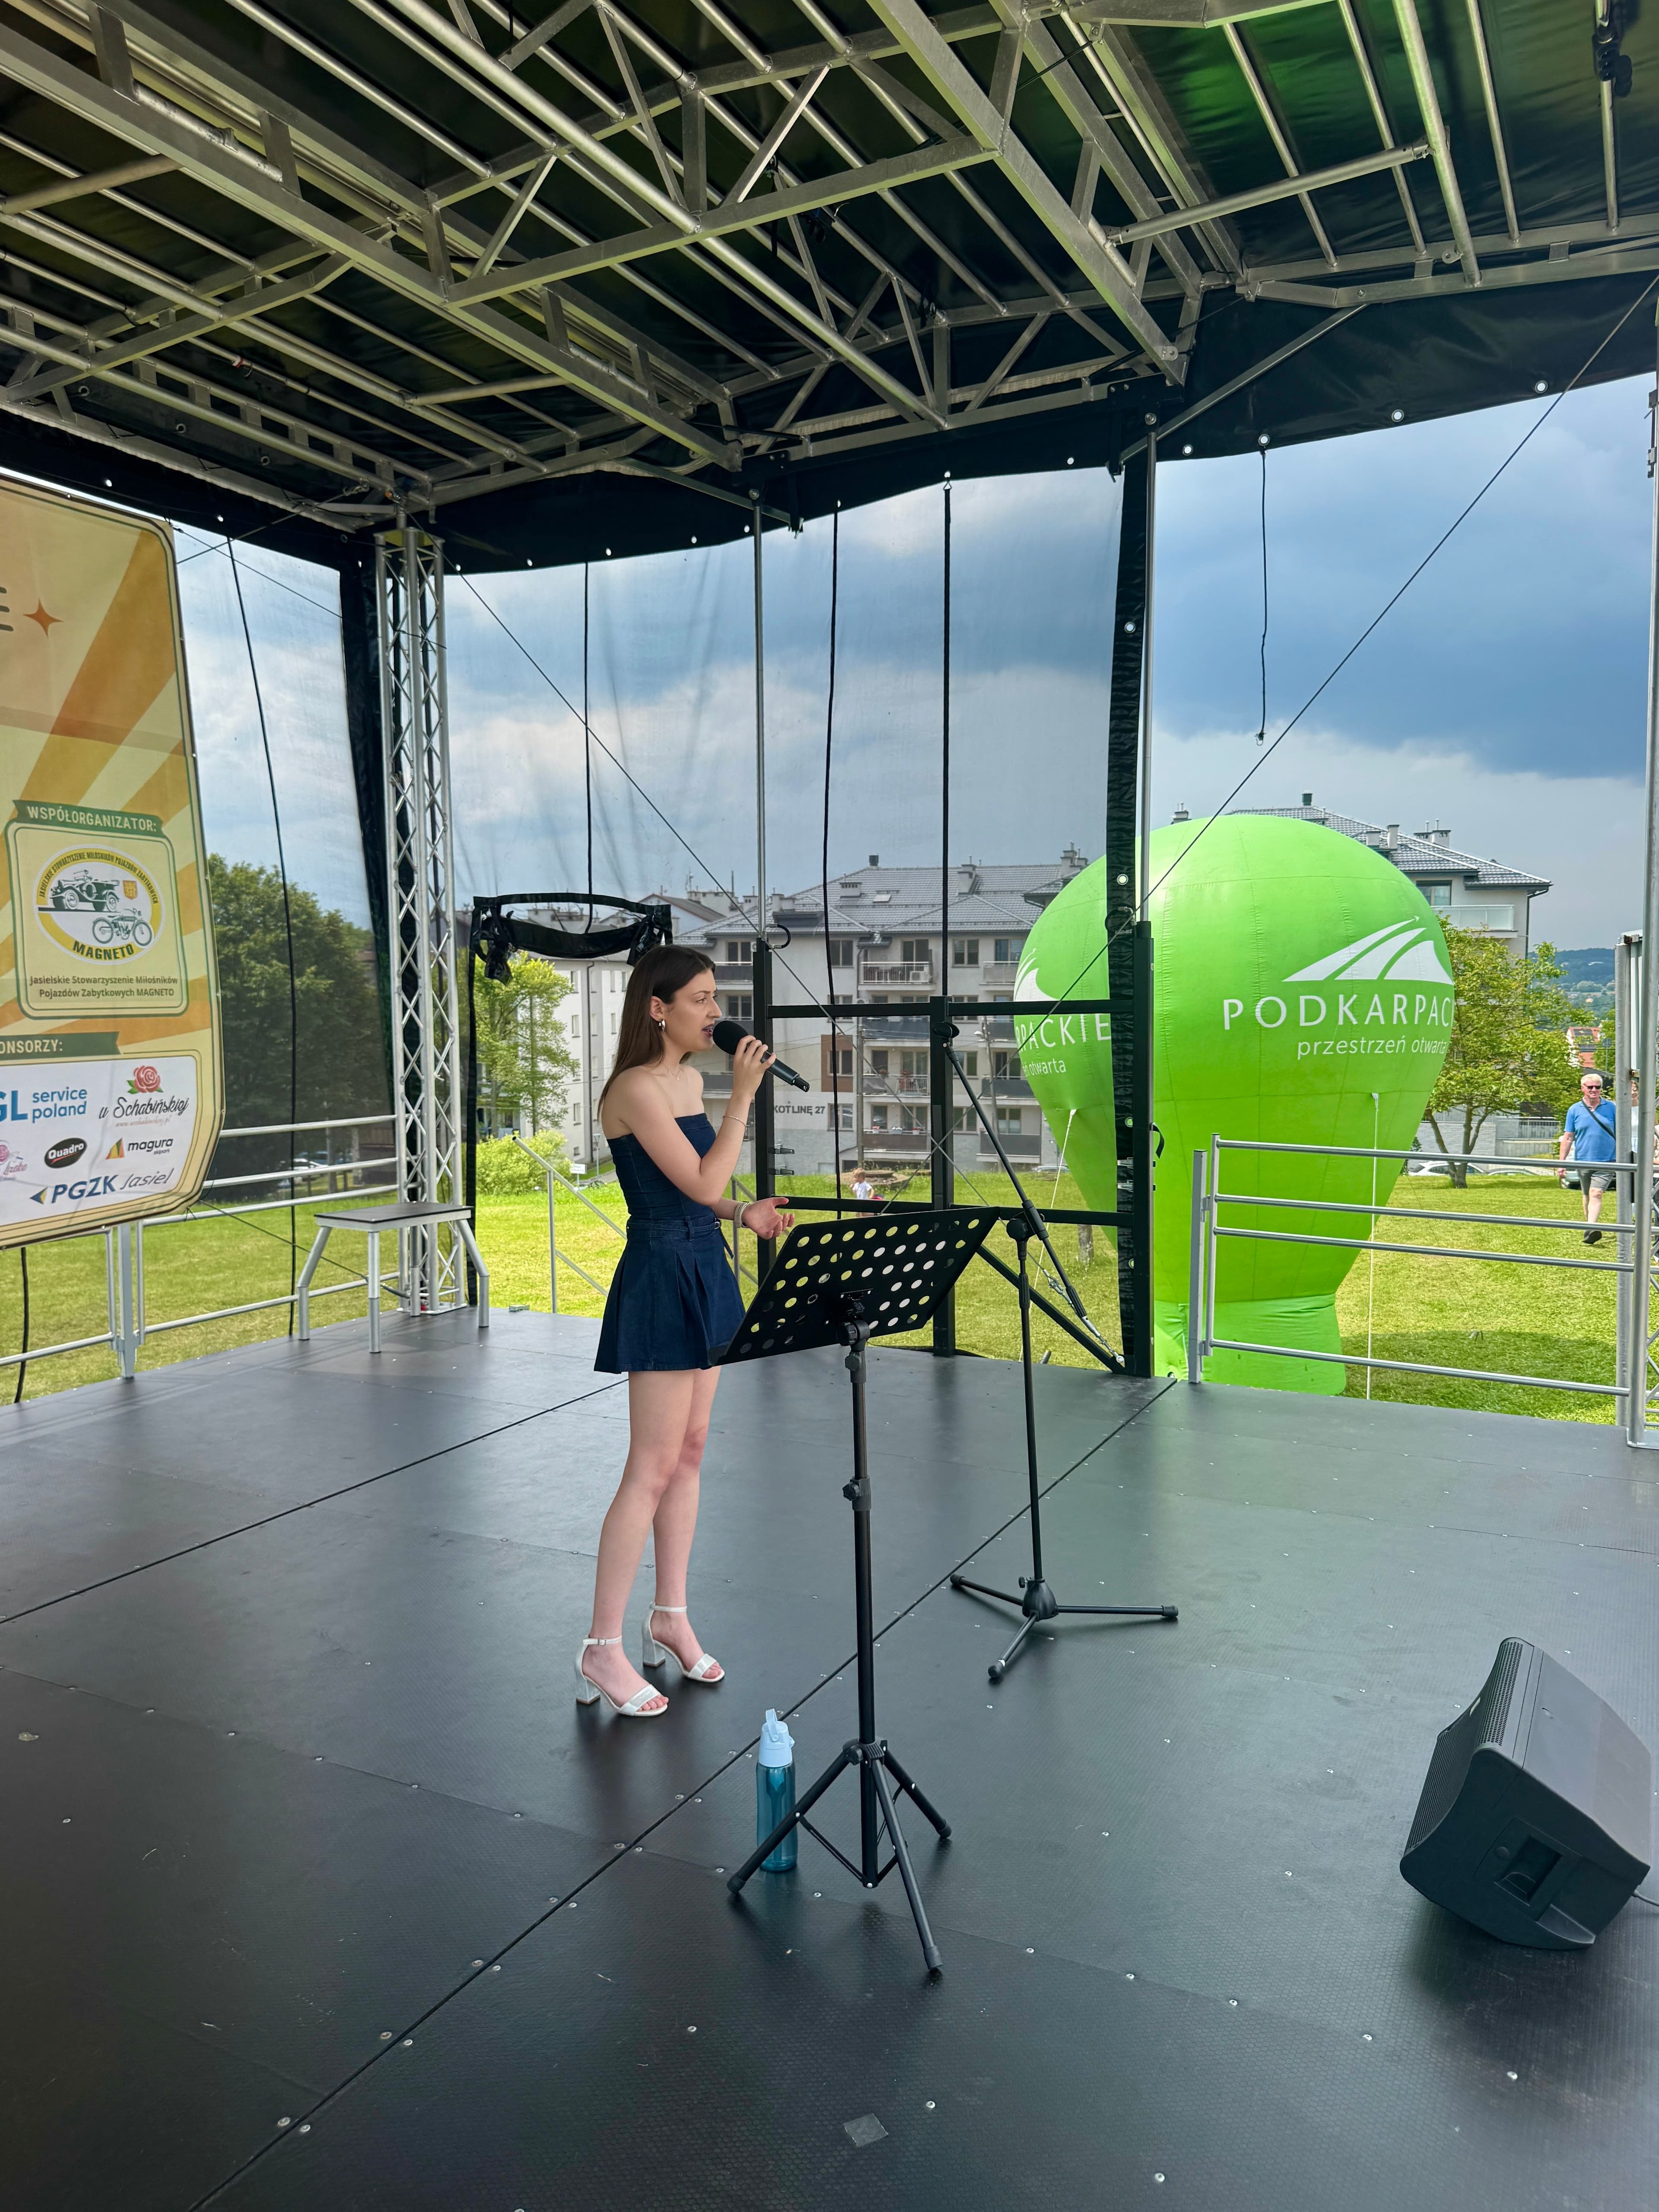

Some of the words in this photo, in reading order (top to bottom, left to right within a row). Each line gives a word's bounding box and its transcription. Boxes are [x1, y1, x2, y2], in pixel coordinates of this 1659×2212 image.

[27, 806, 156, 832] WSPÓŁORGANIZATOR:
[73, 940, 134, 960] MAGNETO
[30, 976, 70, 986] Jasielskie
[72, 976, 134, 986] Stowarzyszenie
[136, 976, 178, 984] Miłośników
[39, 988, 79, 999] Pojazdów
[82, 988, 135, 998] Zabytkowych
[137, 988, 175, 996] MAGNETO
[1223, 994, 1454, 1030] PODKARPAC
[1297, 1035, 1406, 1060] przestrzeń
[1411, 1036, 1447, 1055] otwarta
[1029, 1058, 1066, 1076] otwarta
[32, 1086, 87, 1103] service
[32, 1101, 87, 1123] poland
[99, 1106, 108, 1119] u
[48, 1141, 84, 1160] Quadro
[128, 1138, 174, 1152] magura
[51, 1175, 119, 1204] PGZK
